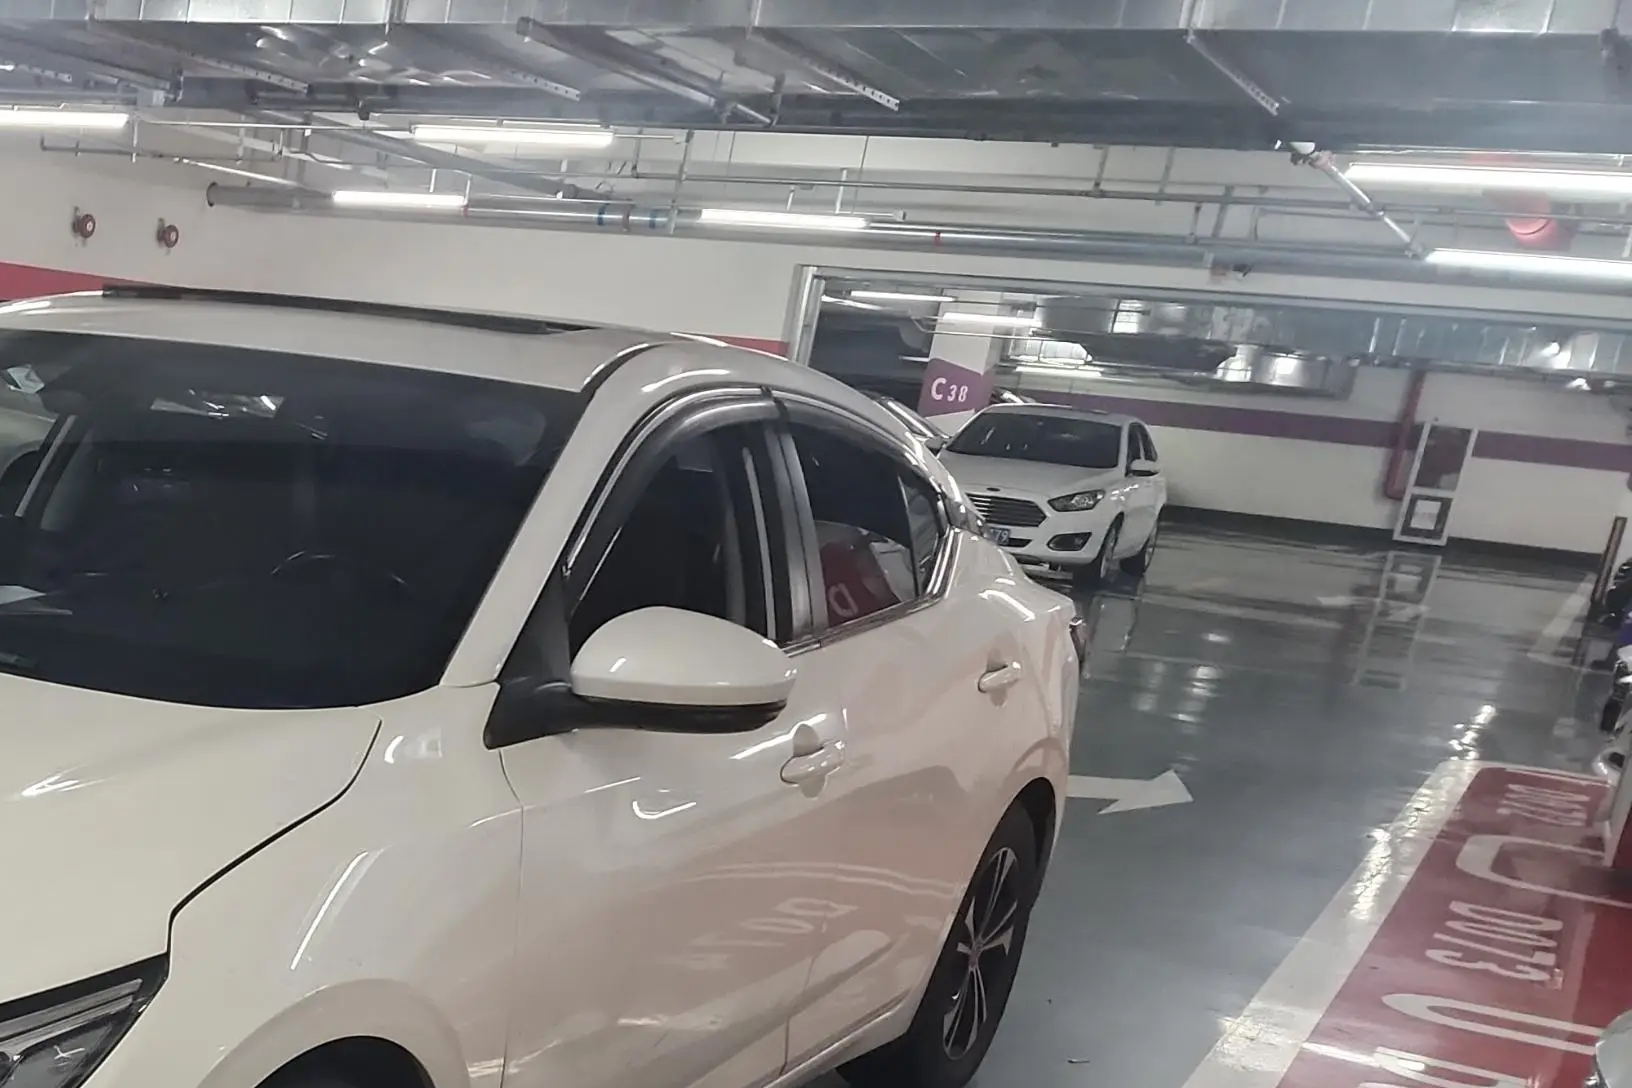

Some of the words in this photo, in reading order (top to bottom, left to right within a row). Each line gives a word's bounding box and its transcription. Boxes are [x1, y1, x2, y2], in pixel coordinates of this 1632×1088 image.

[931, 377, 947, 401] C
[947, 384, 969, 403] 38
[1425, 900, 1564, 982] D073
